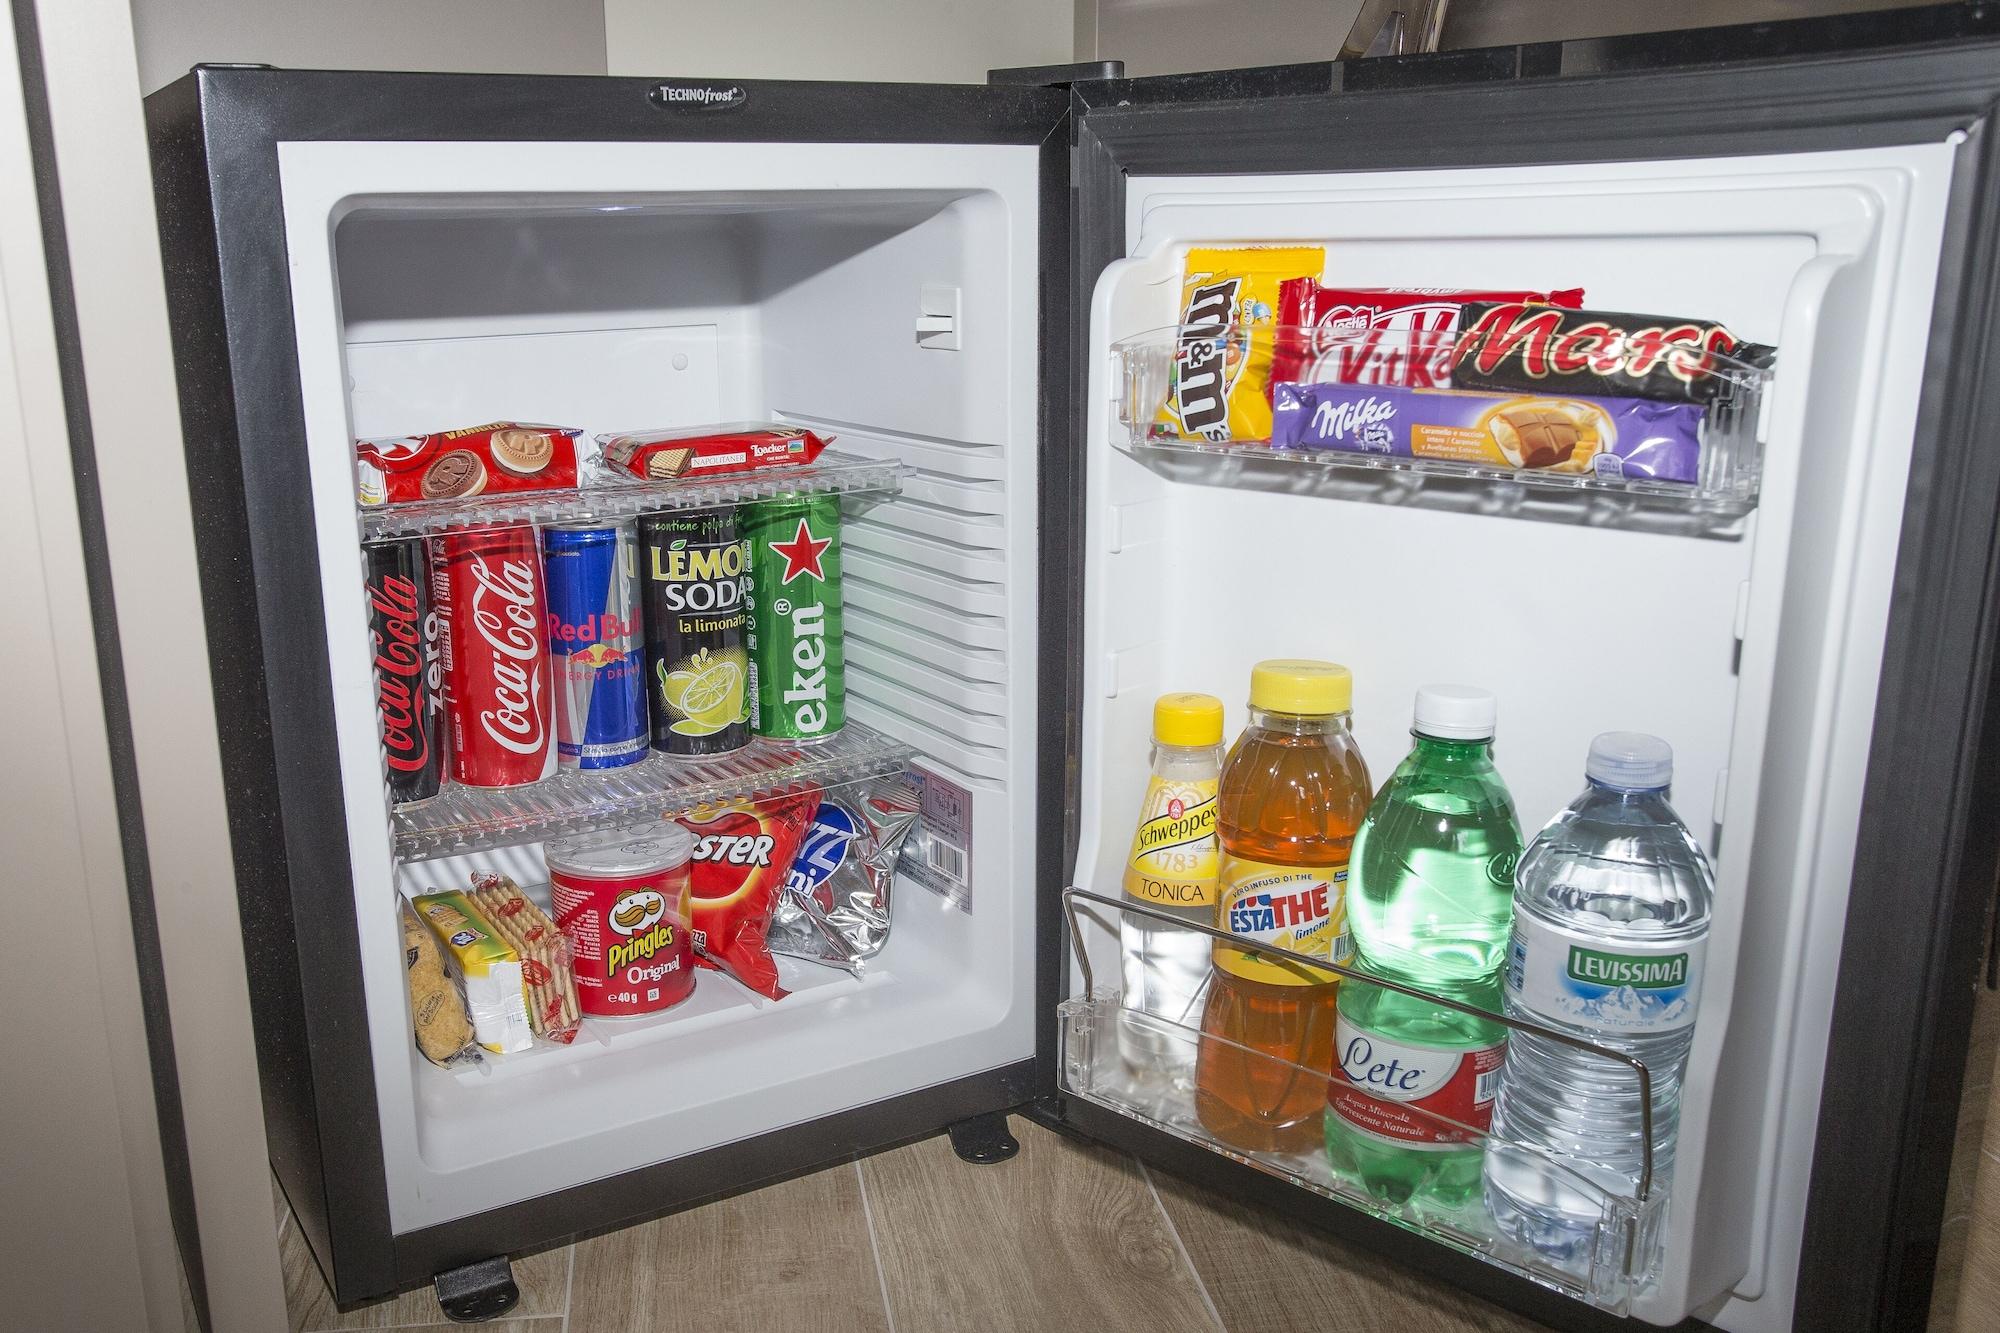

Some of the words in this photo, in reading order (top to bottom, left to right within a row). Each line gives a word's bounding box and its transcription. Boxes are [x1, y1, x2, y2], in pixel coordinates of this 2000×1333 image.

[1452, 303, 1737, 382] Mars
[1312, 396, 1397, 440] Milka
[692, 454, 745, 466] NAPOLITANER
[750, 443, 787, 457] Loacker
[655, 519, 699, 531] contiene
[665, 575, 747, 611] SODA
[548, 613, 597, 642] Red
[680, 619, 691, 633] la
[695, 613, 745, 633] limonata
[424, 611, 446, 716] zero
[470, 550, 544, 755] Coca-Cola
[800, 822, 849, 872] TZ
[1155, 851, 1199, 874] 1783
[788, 867, 815, 895] ni
[1141, 878, 1205, 902] TONICA
[1232, 885, 1250, 898] VERO
[1250, 876, 1281, 890] INFUSO
[1295, 873, 1313, 881] THE
[608, 923, 674, 978] Pringles
[627, 953, 680, 985] Original
[1573, 951, 1683, 983] LEVISSIMA
[1598, 1014, 1656, 1027] aturale
[1340, 1037, 1421, 1090] Lete
[1382, 1120, 1425, 1137] Naturale
